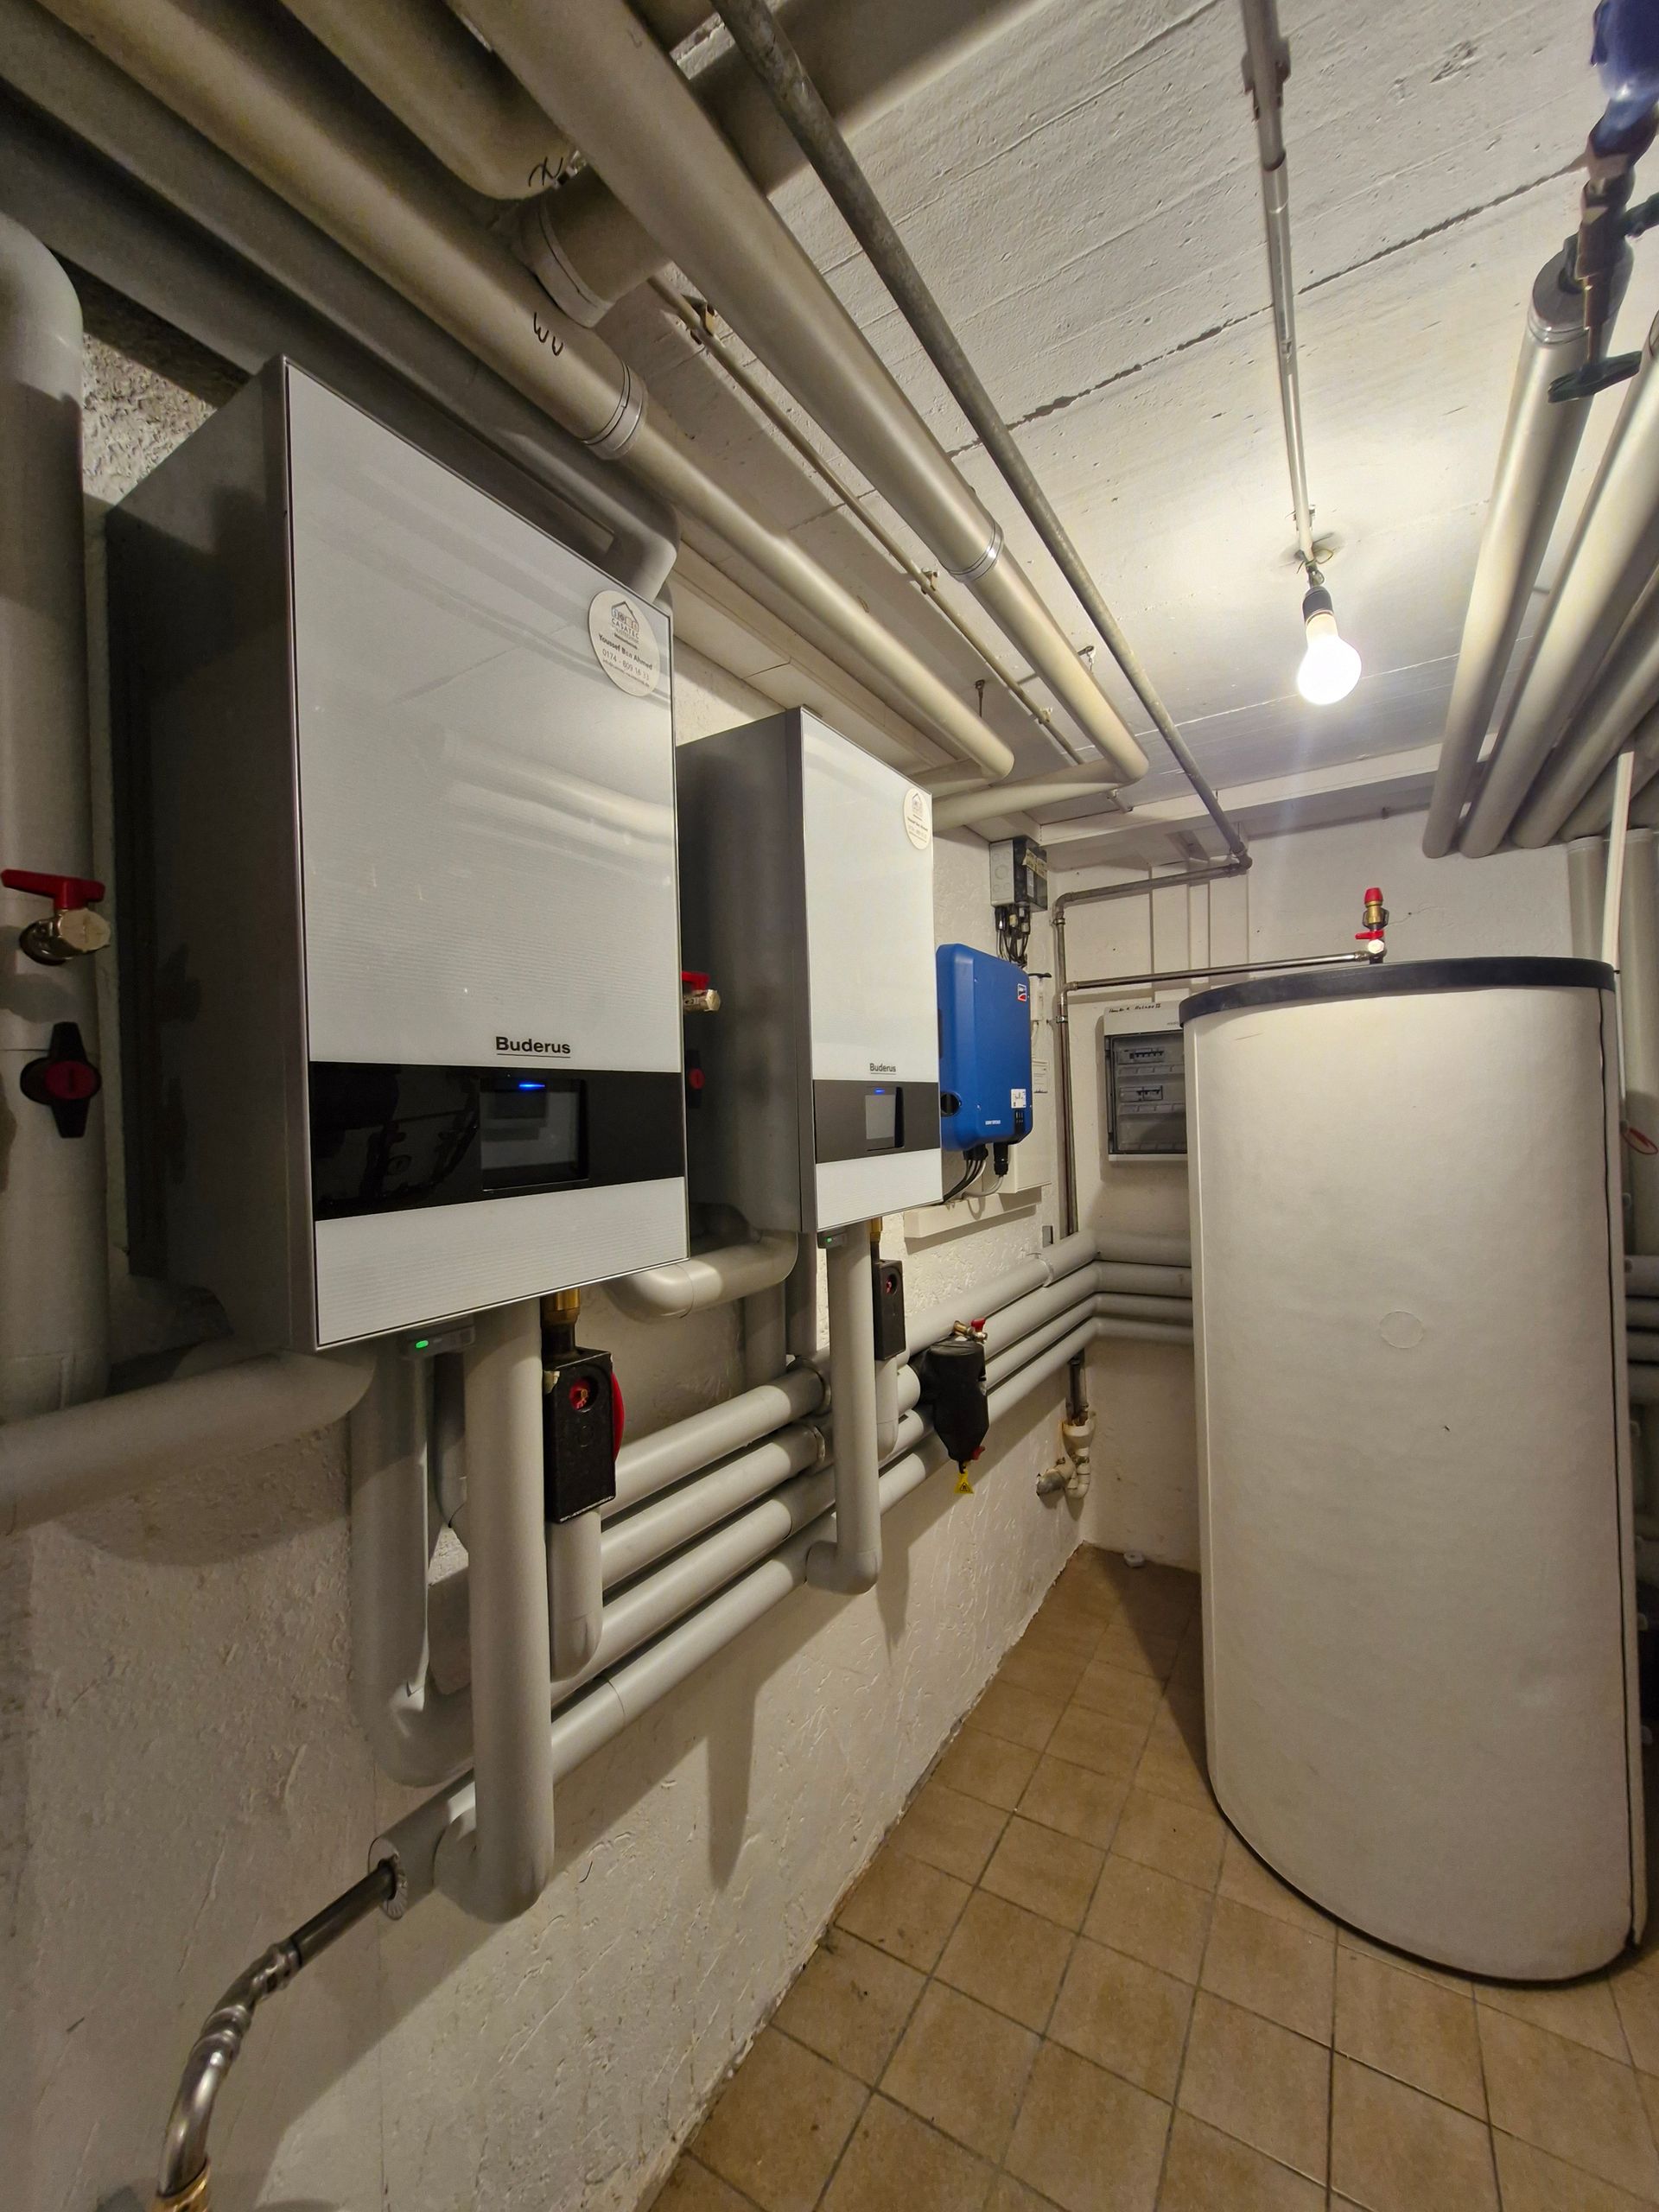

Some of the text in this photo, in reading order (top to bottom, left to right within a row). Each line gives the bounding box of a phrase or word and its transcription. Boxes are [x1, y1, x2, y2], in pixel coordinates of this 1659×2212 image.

[612, 618, 639, 639] CASATEC
[599, 632, 620, 652] Youssef
[621, 647, 632, 658] Ben
[633, 655, 652, 671] Ahmed
[602, 648, 617, 662] 0174
[496, 1036, 570, 1054] Buderus
[869, 1062, 896, 1072] Buderus
